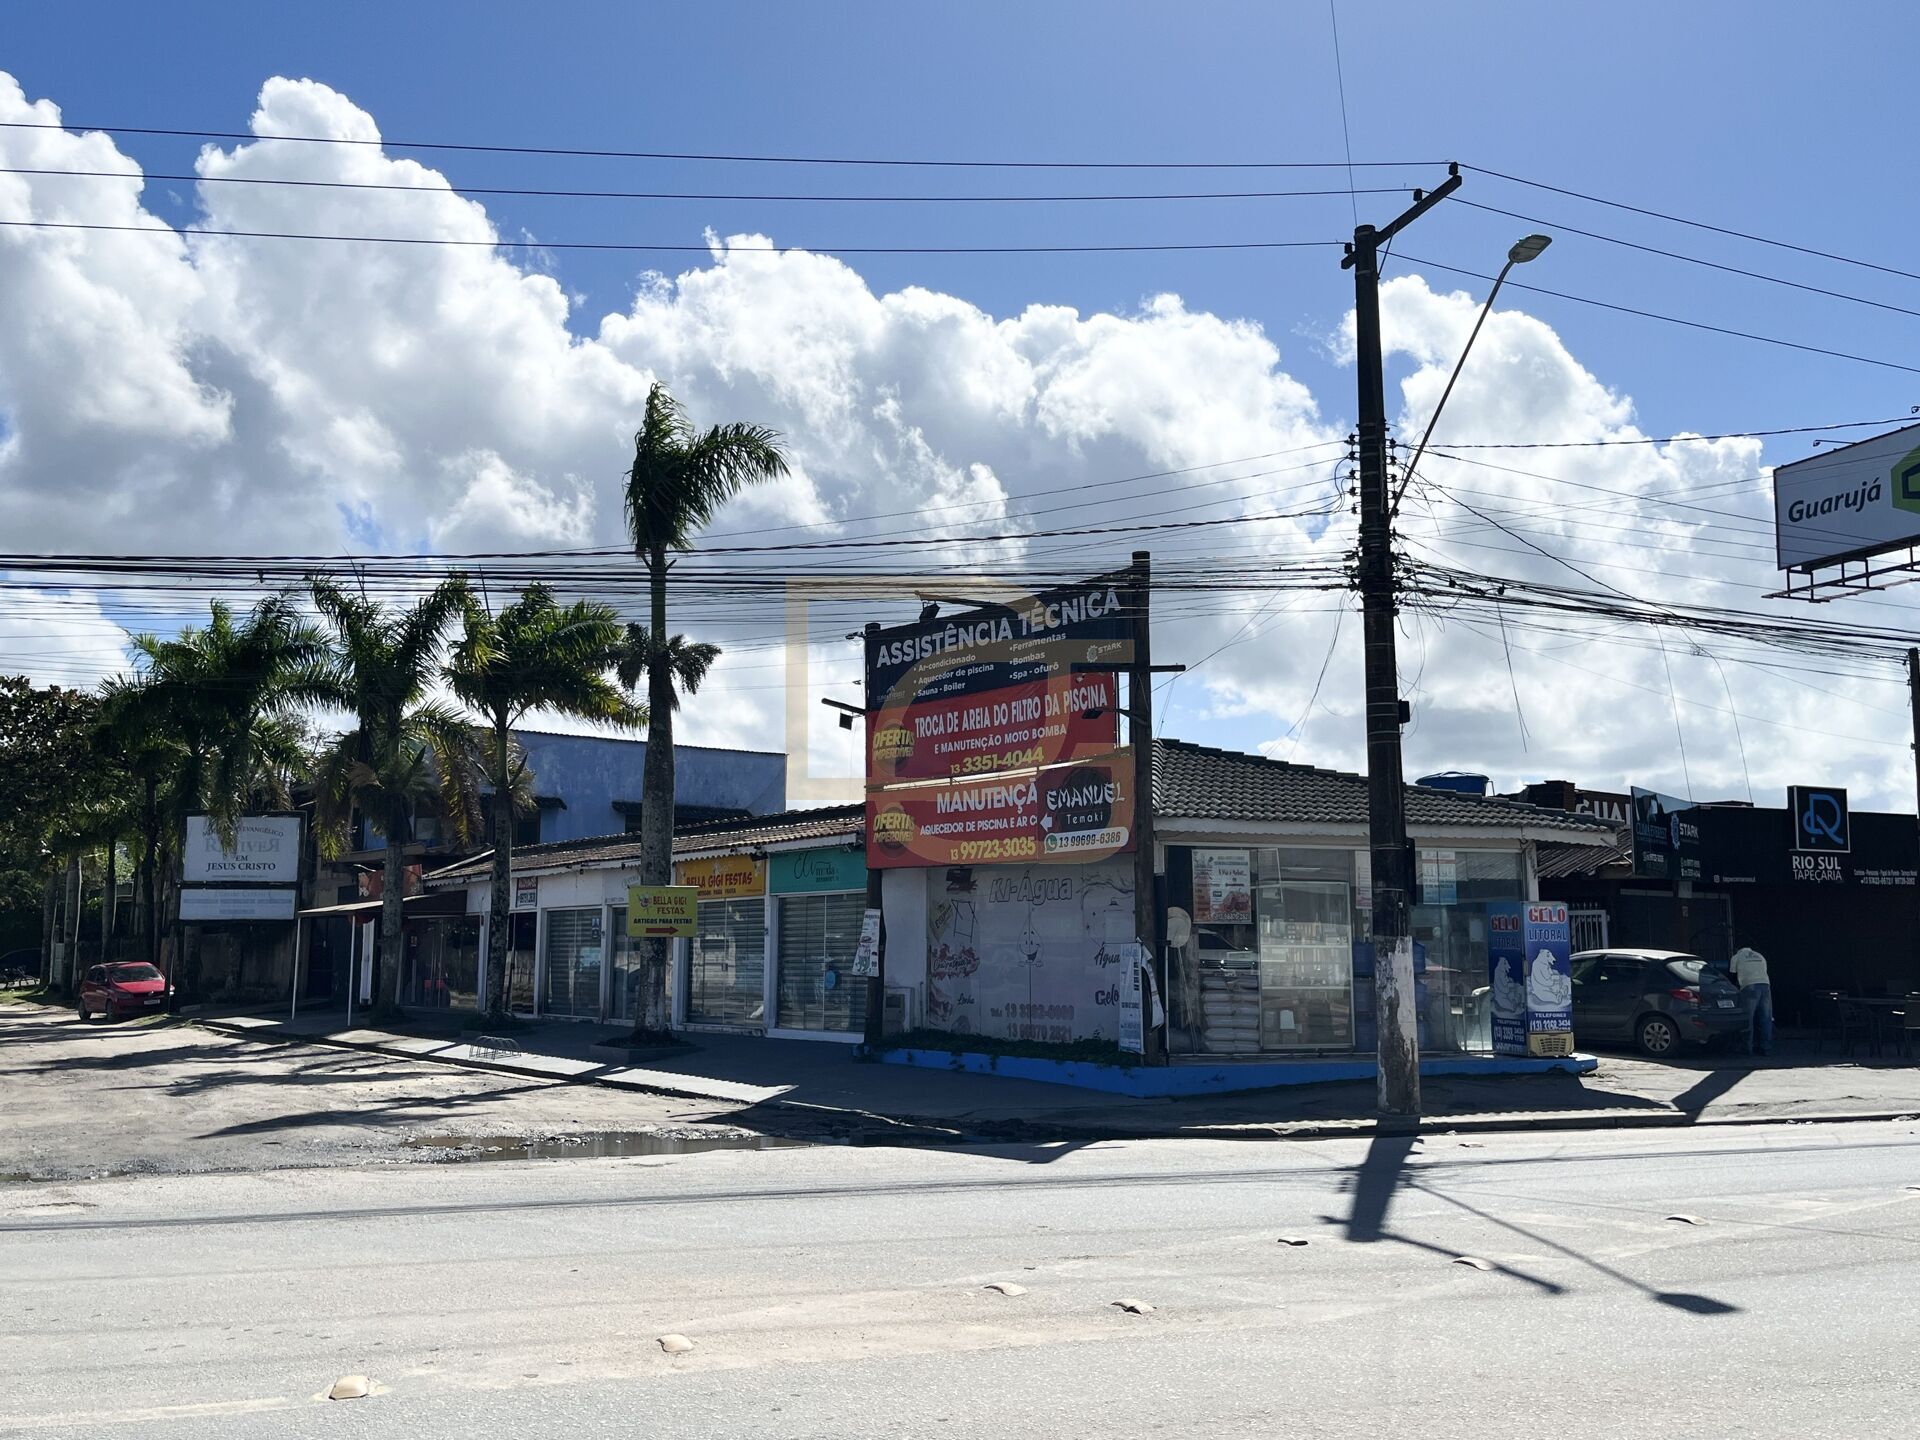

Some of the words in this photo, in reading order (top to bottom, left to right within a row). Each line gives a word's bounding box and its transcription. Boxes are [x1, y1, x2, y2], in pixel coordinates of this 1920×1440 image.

[1788, 477, 1881, 523] Guarujá
[877, 617, 1013, 668] ASSISTÊNCIA
[1018, 589, 1121, 636] TÉCNICA
[1012, 632, 1067, 651] Ferramentas
[918, 654, 976, 672] Ar-condicionado
[1012, 652, 1046, 665] Bombas
[918, 671, 955, 685] Aquecedor
[955, 668, 966, 677] de
[967, 663, 994, 676] piscina
[1012, 670, 1028, 681] Spa
[917, 688, 938, 697] Sauna
[943, 682, 966, 692] Boiler
[915, 715, 945, 738] TROCA
[947, 713, 959, 733] DE
[962, 708, 991, 731] AREIA
[994, 704, 1008, 727] DO
[1011, 698, 1041, 724] FILTRO
[1045, 693, 1060, 717] DA
[1063, 683, 1108, 714] PISCINA
[934, 743, 939, 755] E
[941, 733, 1001, 754] MANUTENÇÃO
[1004, 730, 1029, 744] MOTO
[1032, 723, 1067, 739] BOMBA
[950, 764, 961, 774] 13
[962, 747, 1044, 773] 3351-4044
[1046, 782, 1125, 810] EMANUEL
[920, 822, 964, 836] AQUECEDOR
[966, 821, 975, 832] DE
[977, 818, 1008, 831] PISCINA
[1010, 816, 1015, 828] E
[1016, 815, 1028, 828] AR
[1679, 822, 1699, 839] STARK
[950, 849, 959, 860] 13
[960, 836, 1036, 859] 99723-3035
[1059, 837, 1068, 848] 13
[206, 862, 236, 873] JESUS
[238, 862, 276, 870] CRISTO
[1792, 855, 1815, 869] RIO
[1817, 856, 1841, 870] SUL
[687, 875, 706, 887] BELLA
[708, 874, 723, 887] GIGI
[725, 872, 752, 886] FESTAS
[1792, 869, 1842, 883] TAPEÇARIA
[653, 896, 672, 905] BELLA
[673, 896, 687, 905] GIGI
[657, 907, 685, 915] FESTAS
[1528, 906, 1566, 923] GELO
[1491, 915, 1519, 931] GELO
[1528, 929, 1567, 941] LITORAL
[1094, 943, 1120, 968] Água
[1095, 984, 1119, 1006] Gelo
